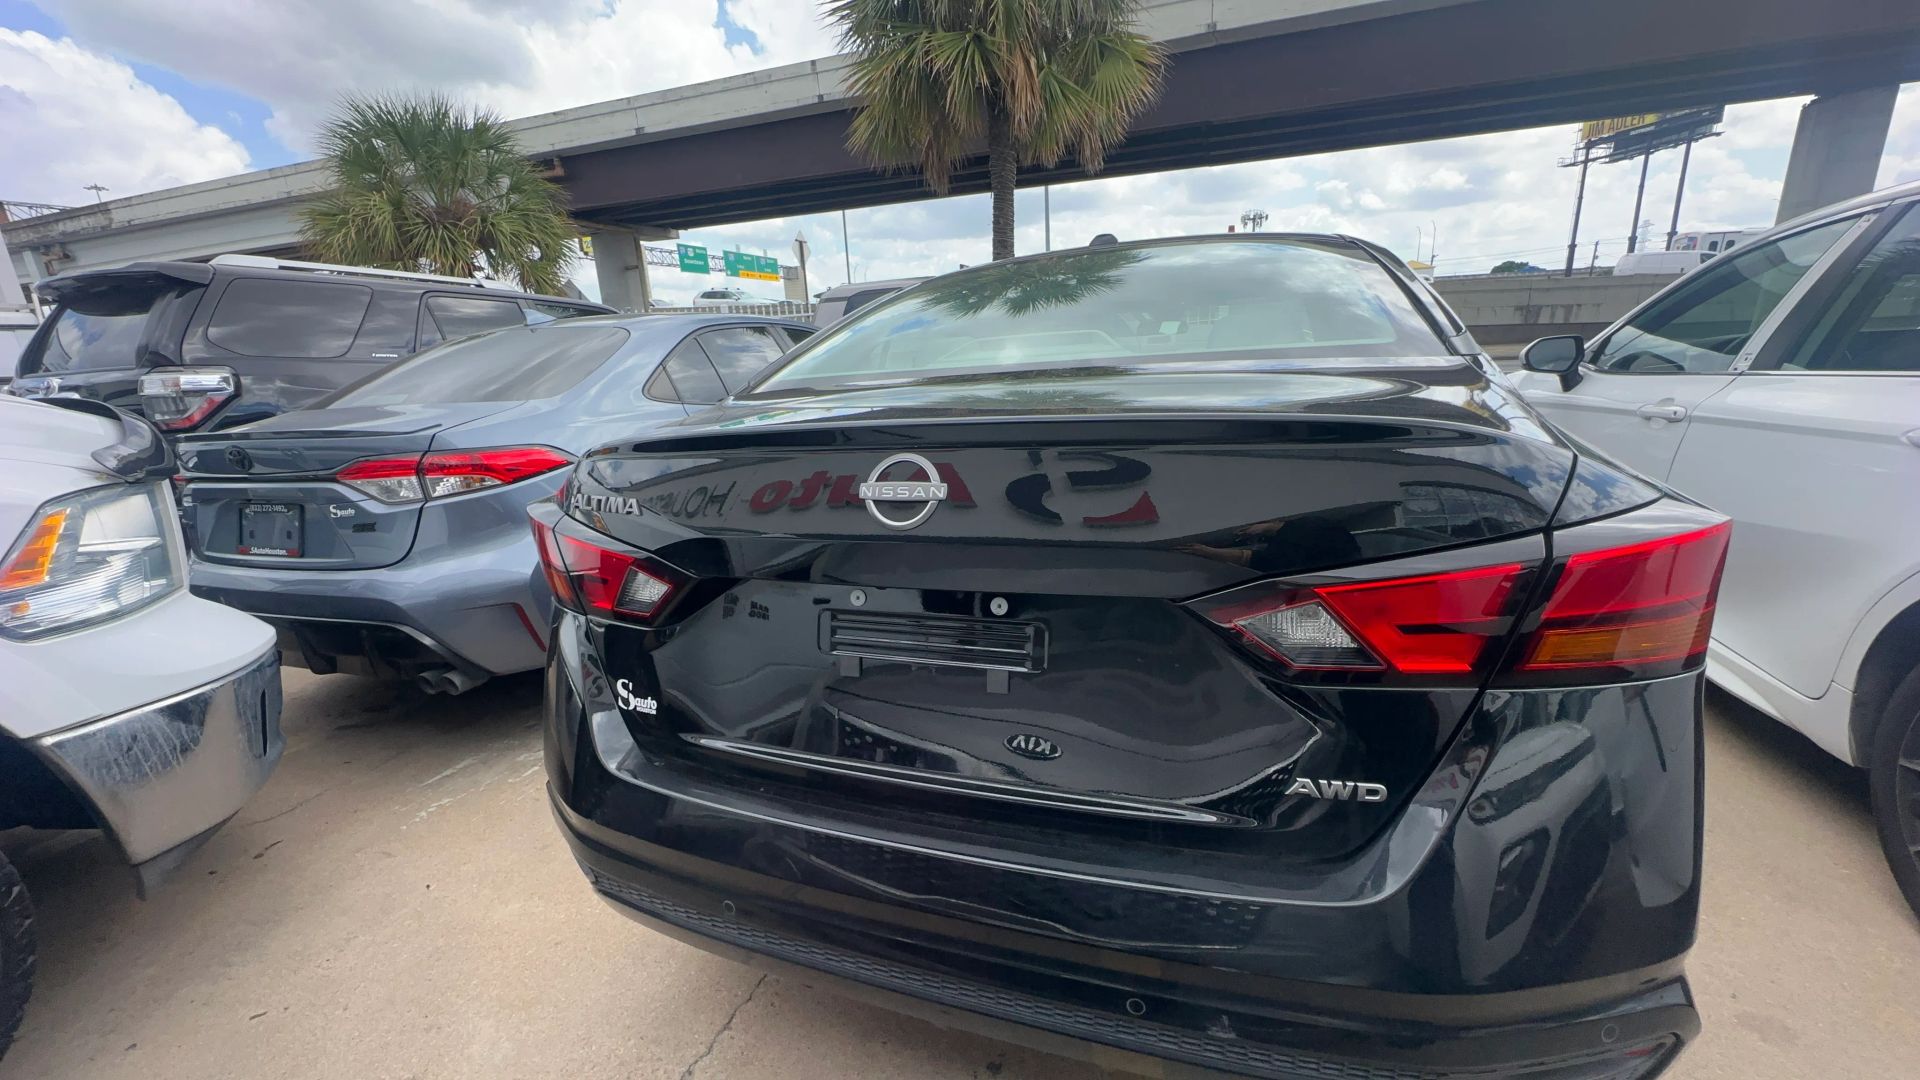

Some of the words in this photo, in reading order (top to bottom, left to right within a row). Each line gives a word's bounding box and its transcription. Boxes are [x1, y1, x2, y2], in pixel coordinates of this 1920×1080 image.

[1586, 120, 1606, 138] JIM
[861, 486, 944, 498] NISSAN
[571, 494, 641, 516] ALTIMA
[1285, 778, 1387, 802] AWD
